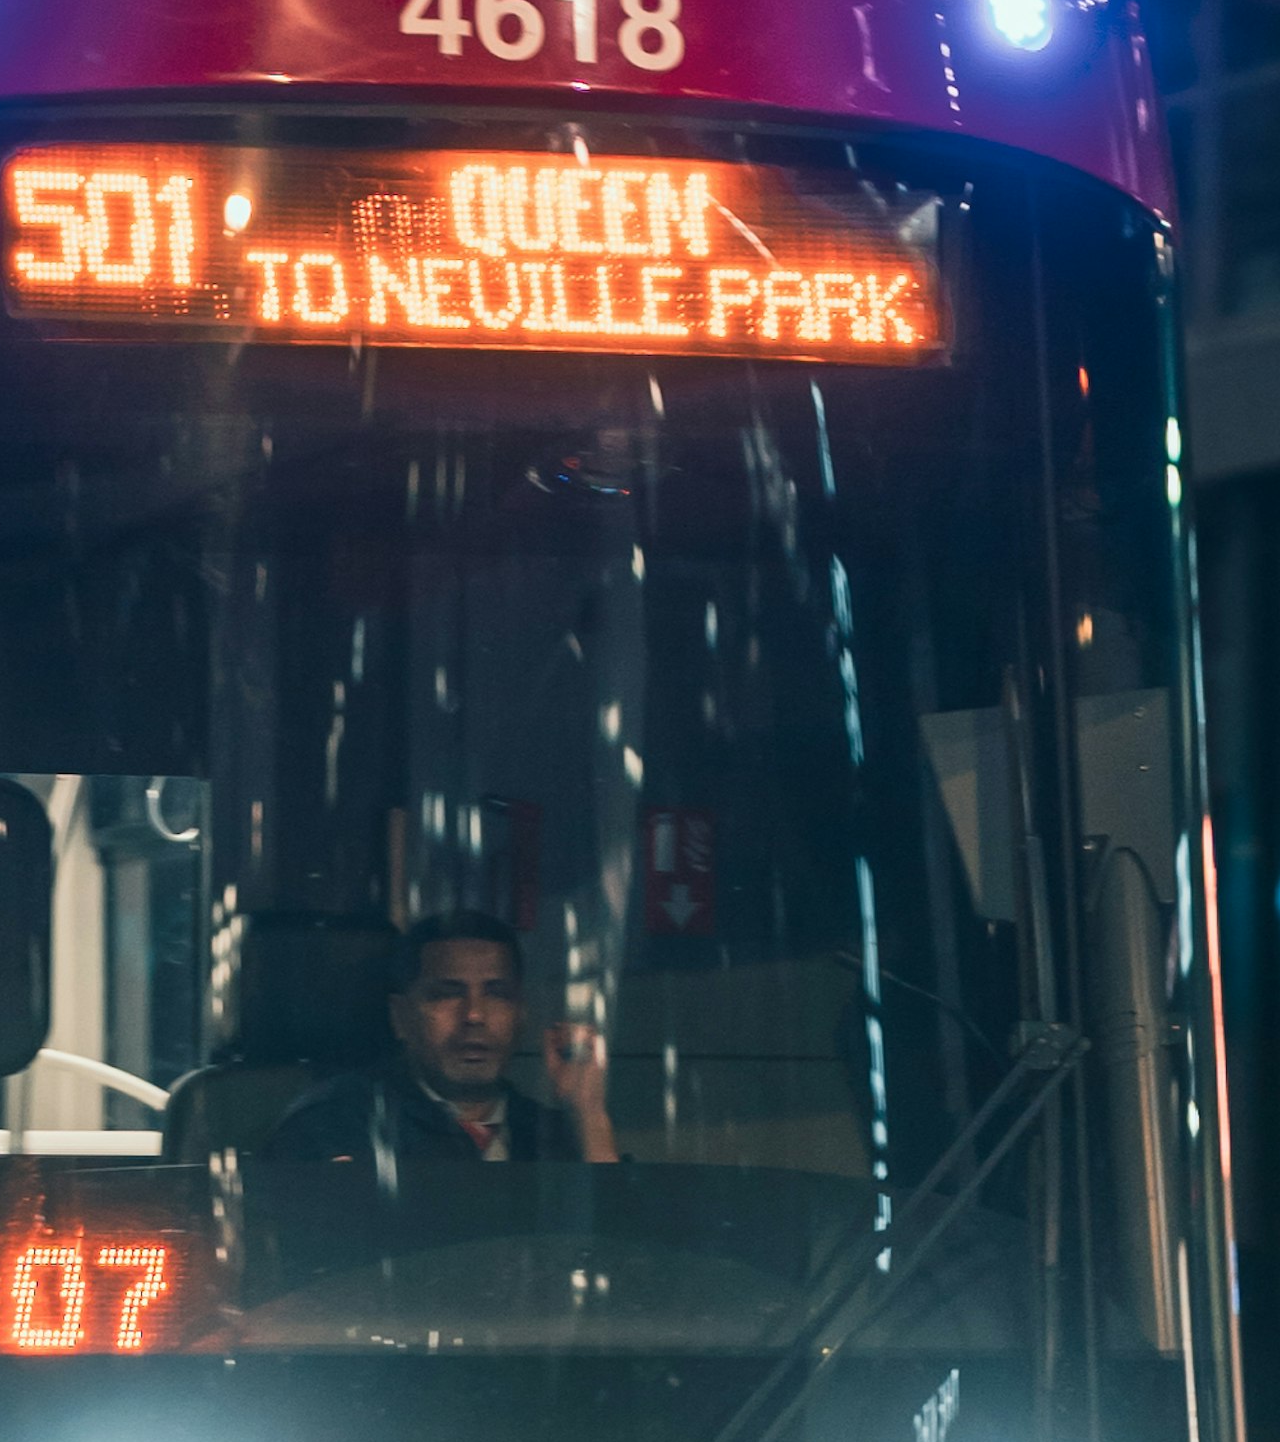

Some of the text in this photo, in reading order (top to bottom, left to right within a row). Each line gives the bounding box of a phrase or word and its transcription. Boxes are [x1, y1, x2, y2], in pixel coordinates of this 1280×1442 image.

[11, 164, 711, 286] 501 QUEEN
[247, 251, 914, 345] TO NEVILLE PARK
[11, 1247, 167, 1348] 07
